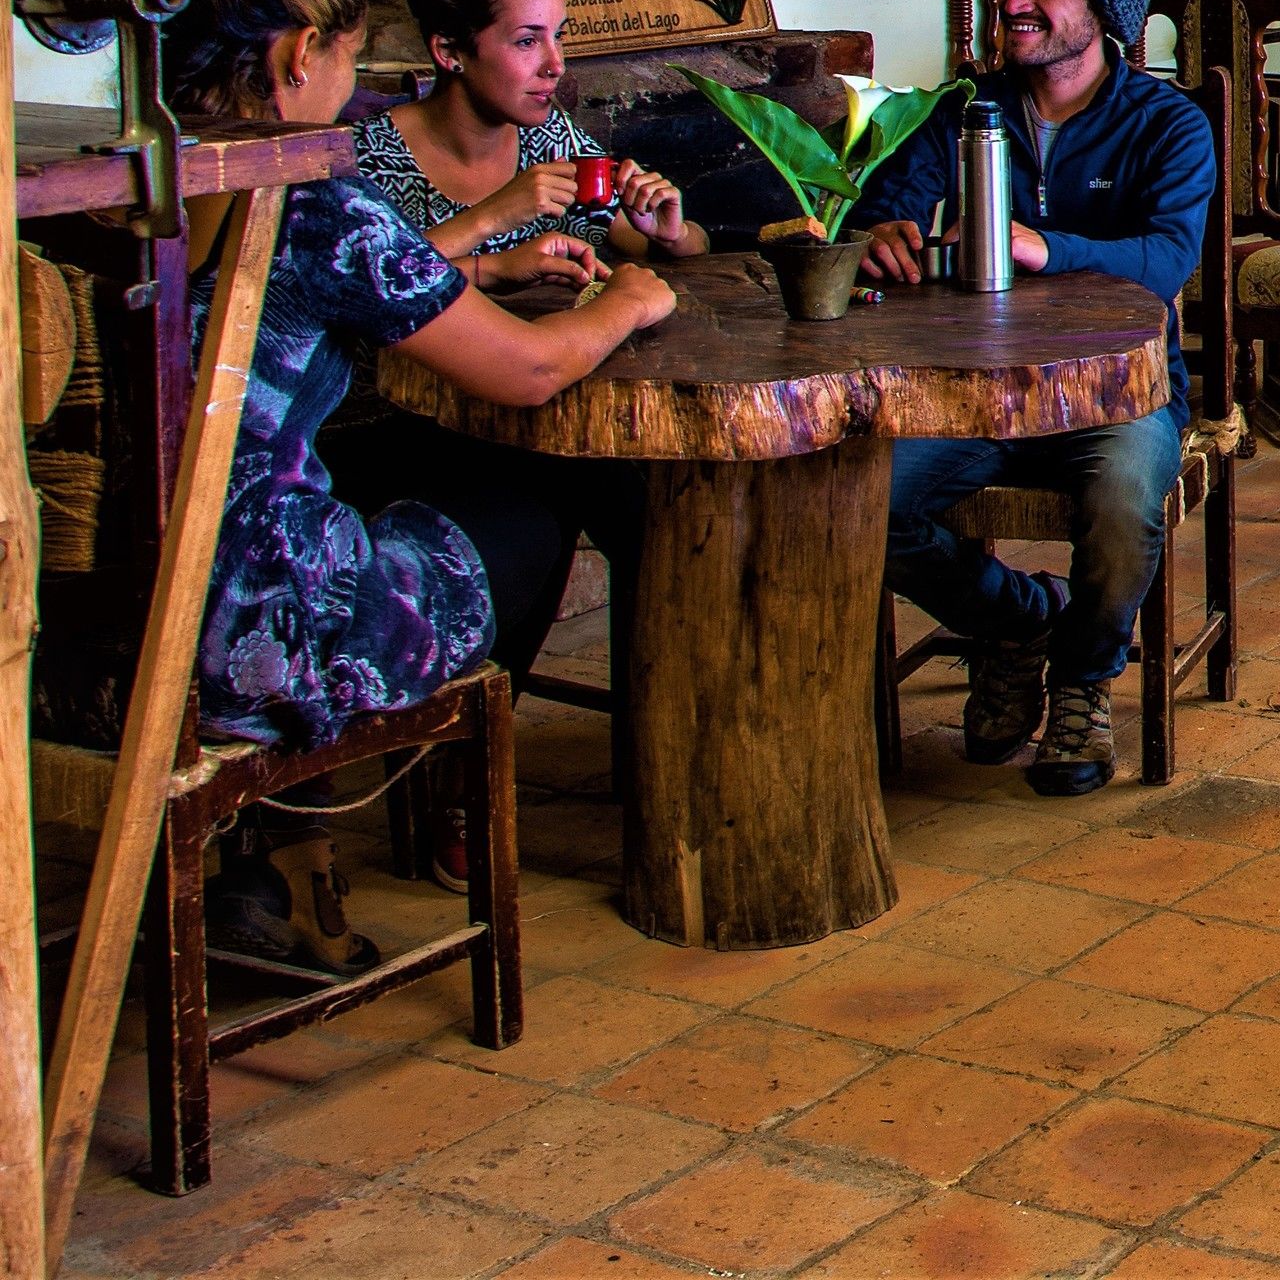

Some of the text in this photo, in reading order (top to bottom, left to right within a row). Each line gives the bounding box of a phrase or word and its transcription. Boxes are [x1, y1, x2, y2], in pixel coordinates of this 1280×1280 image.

[568, 11, 680, 36] Balcón del Lago
